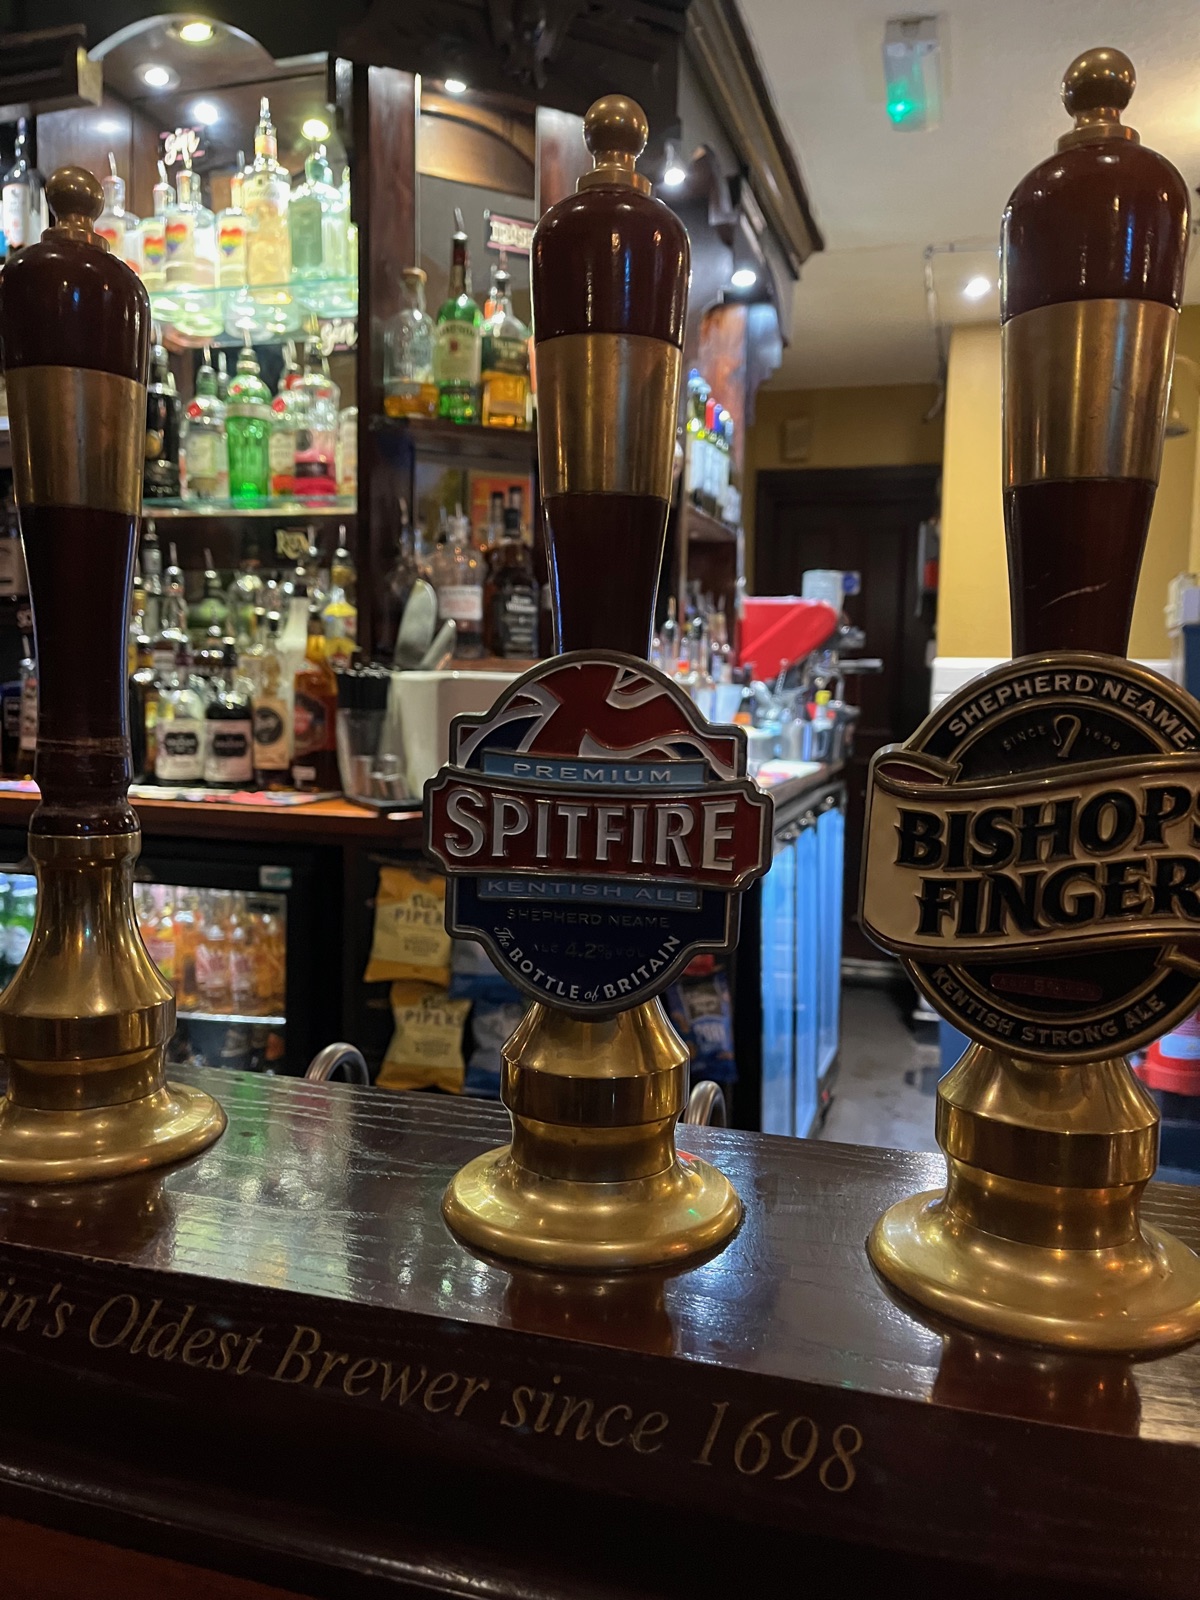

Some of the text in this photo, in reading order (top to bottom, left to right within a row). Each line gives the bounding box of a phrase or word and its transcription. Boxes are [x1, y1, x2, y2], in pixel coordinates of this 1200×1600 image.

[949, 674, 1196, 749] SHEPHERD NEAME
[1003, 725, 1046, 751] SINCE
[513, 763, 671, 782] PREMIUM
[444, 788, 739, 872] SPITFIRE
[894, 785, 1200, 871] BISHOP
[395, 908, 444, 926] PIPER
[487, 881, 694, 903] KENTISH ALE
[507, 908, 670, 930] SHEPHERD NEAME
[914, 855, 1200, 938] FINGER
[494, 926, 681, 1002] The BOTTLE of BRITAIN
[931, 967, 1167, 1046] KENTISH STRONG ALE
[89, 1294, 264, 1375] Oldest
[269, 1325, 490, 1417] Brewer
[500, 1375, 669, 1454] since
[691, 1401, 863, 1493] 1698
